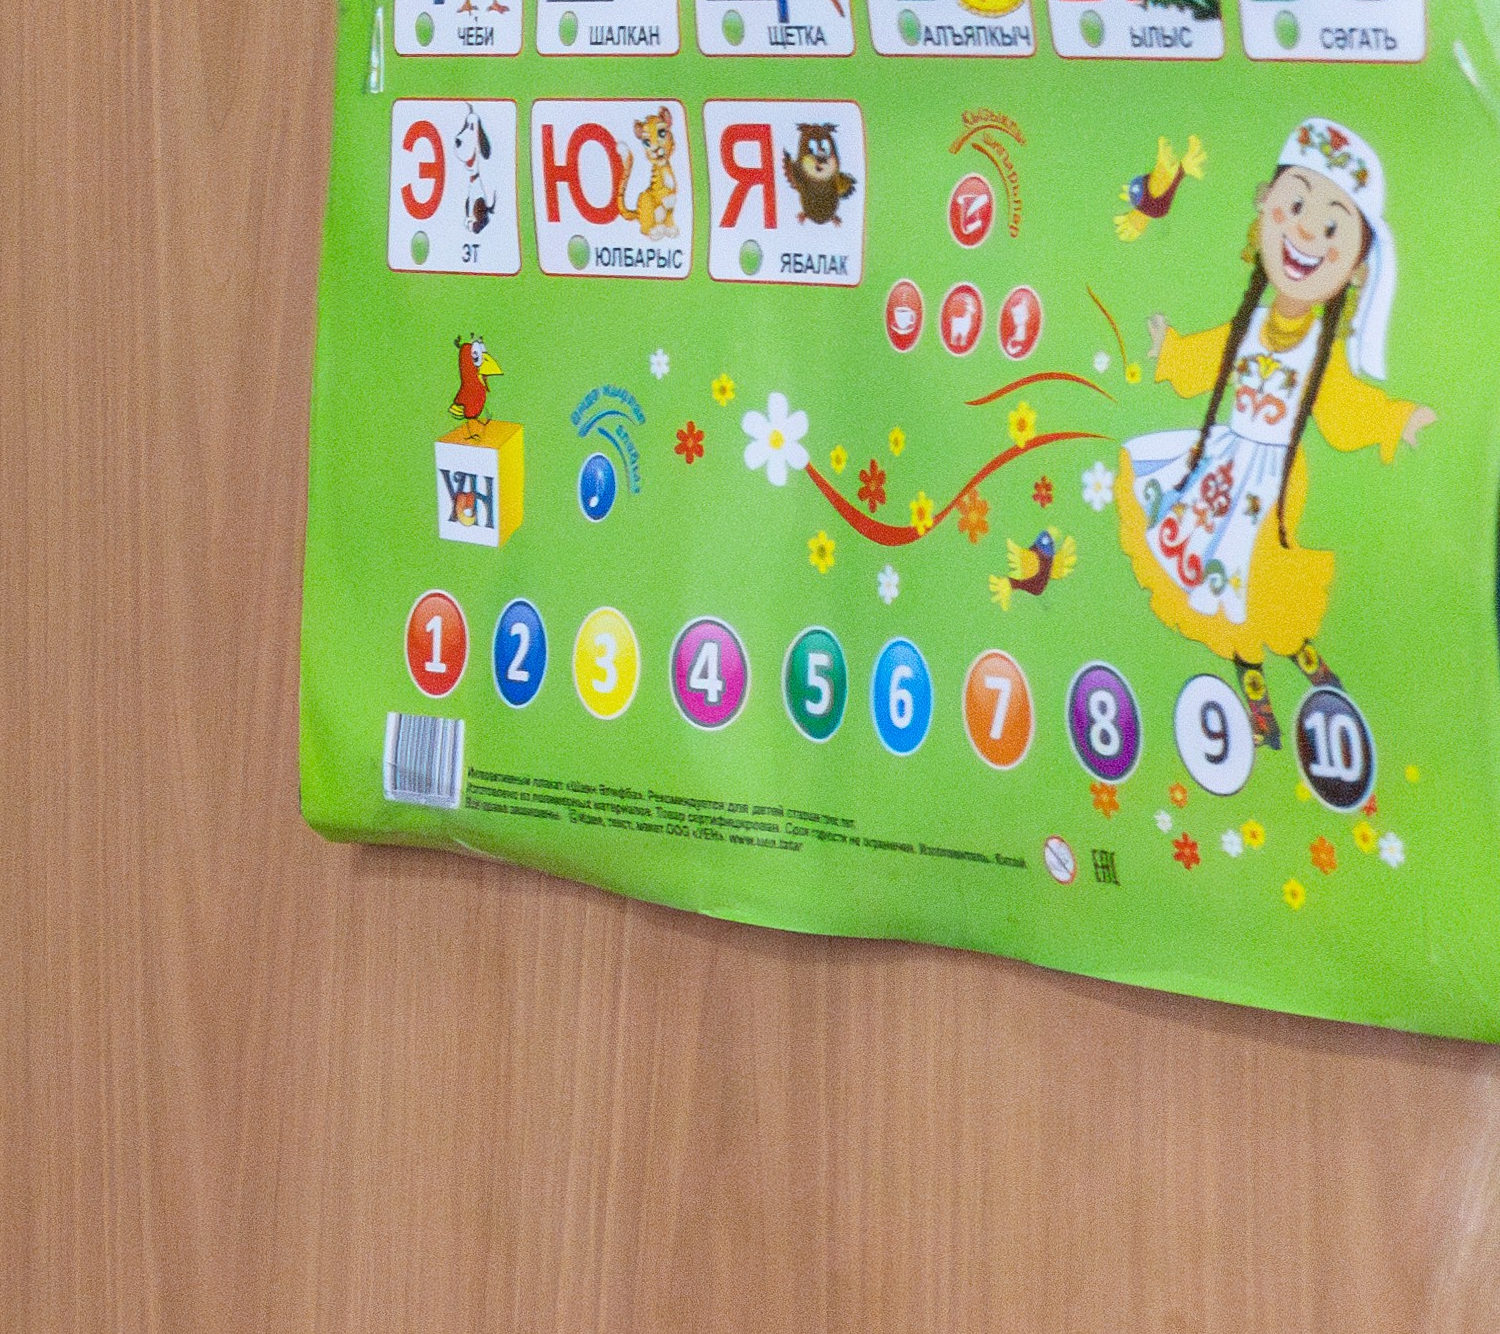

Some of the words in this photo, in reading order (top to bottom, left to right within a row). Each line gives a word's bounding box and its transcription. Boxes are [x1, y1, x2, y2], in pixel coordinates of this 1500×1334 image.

[457, 26, 494, 46] ЧЕБИ
[589, 24, 660, 46] ШАЛКАН
[768, 25, 828, 49] ЩЕТКА
[923, 25, 1031, 47] АЛЪЯПКЫЧ
[1130, 26, 1193, 49] ЫЛЫС
[400, 120, 445, 220] Э
[542, 123, 622, 224] Ю
[719, 123, 777, 230] Я
[461, 243, 480, 263] ЭТ
[595, 247, 683, 269] ЮЛБАРЫС
[780, 253, 848, 275] ЯБАЛАК
[425, 615, 446, 673] 1
[508, 622, 530, 682] 2
[591, 633, 617, 694] 3
[689, 640, 723, 703] 4
[805, 652, 832, 716] 5
[889, 664, 913, 727] 6
[984, 676, 1011, 741] 7
[1087, 688, 1121, 757] 8
[1201, 700, 1228, 764] 9
[1304, 713, 1363, 783] 10
